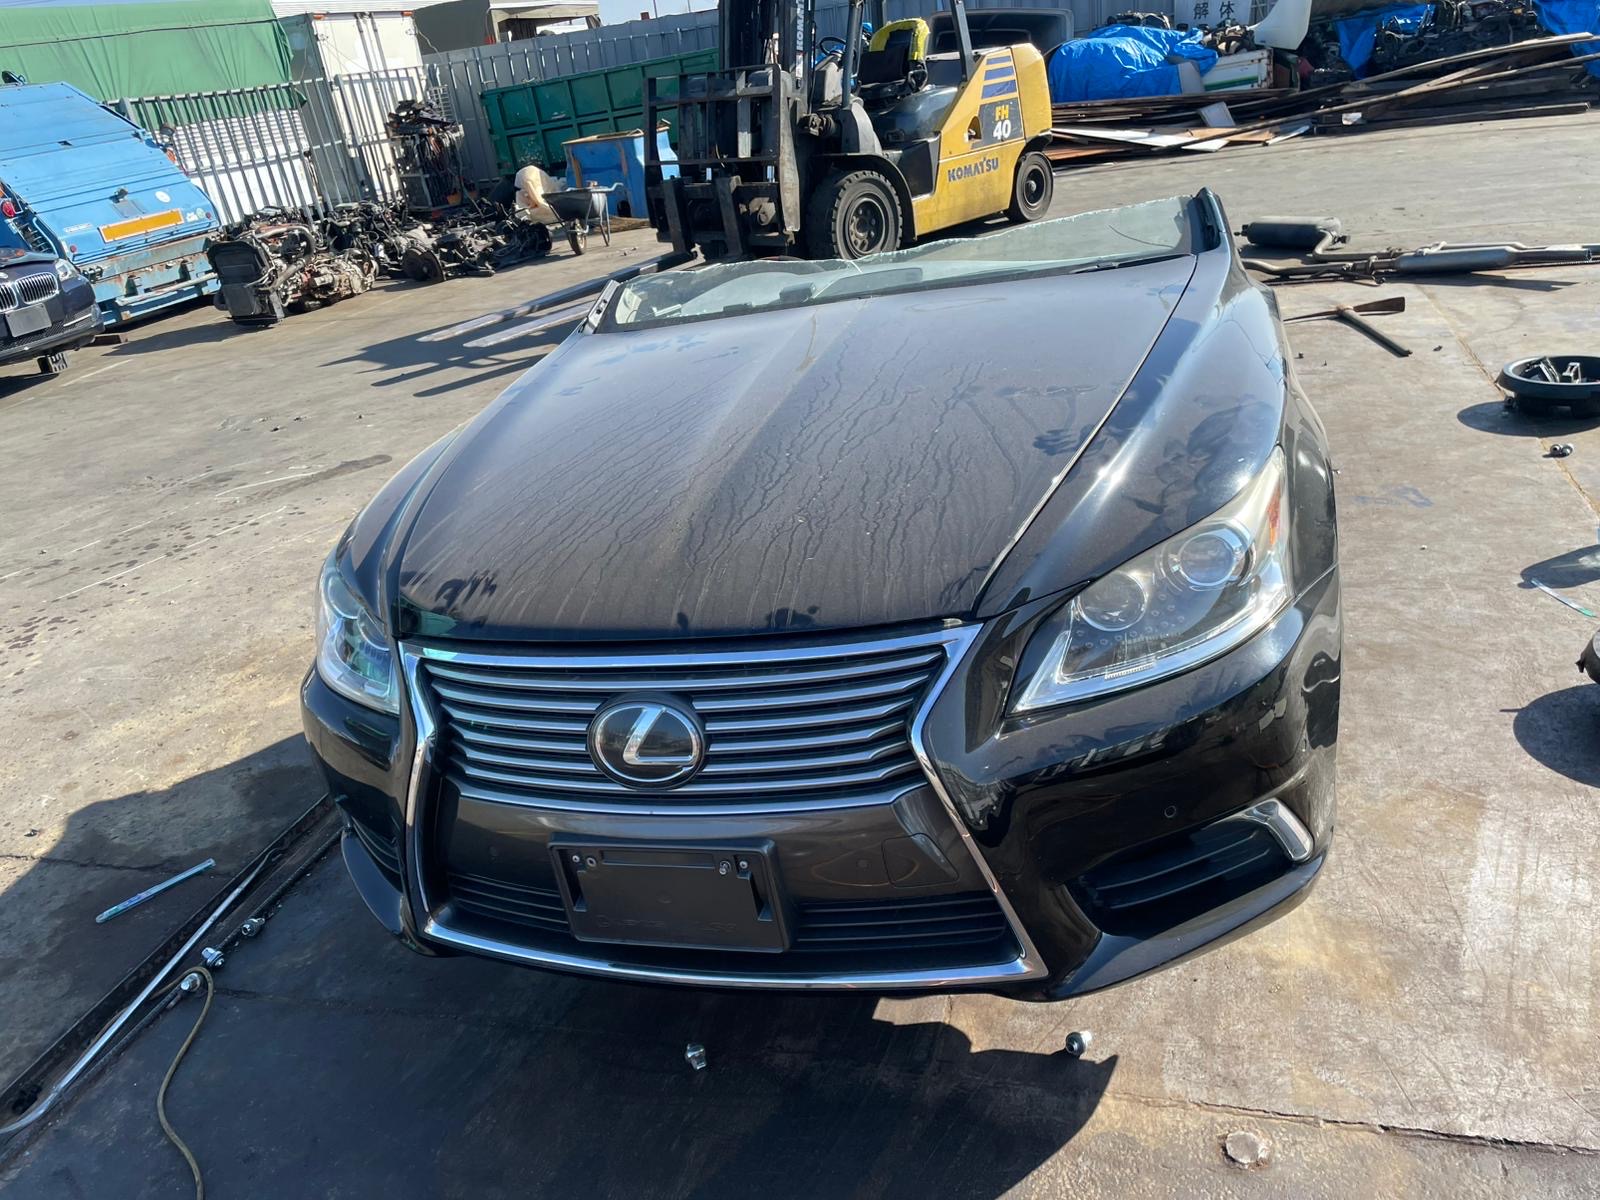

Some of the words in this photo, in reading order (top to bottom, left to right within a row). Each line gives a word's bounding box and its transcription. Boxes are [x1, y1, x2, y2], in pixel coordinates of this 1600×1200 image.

[1193, 0, 1235, 20] 解体
[796, 0, 805, 51] KOMAT
[995, 105, 1010, 121] FH
[993, 121, 1012, 140] 40
[948, 157, 999, 182] KOMATSU
